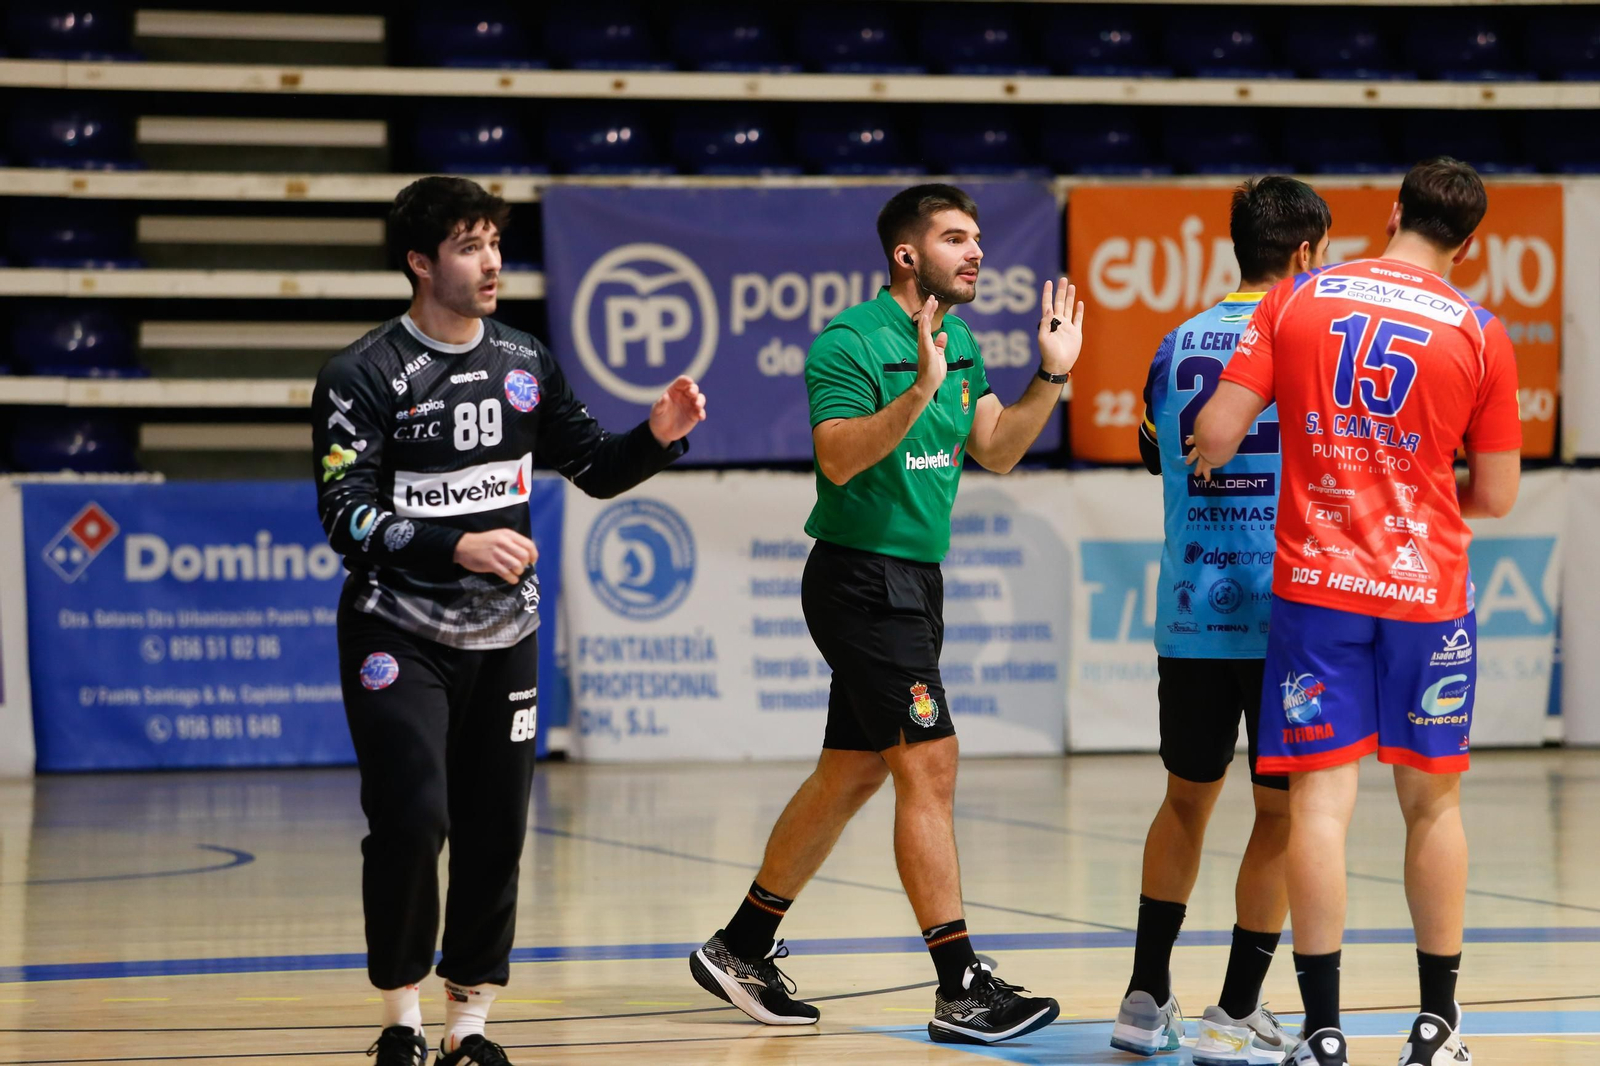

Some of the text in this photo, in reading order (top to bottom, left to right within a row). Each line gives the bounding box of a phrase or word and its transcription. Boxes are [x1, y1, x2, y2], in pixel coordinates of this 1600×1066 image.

[1347, 291, 1392, 304] GROUP
[1350, 281, 1463, 317] SAVILCON
[605, 295, 692, 368] PP
[1181, 332, 1196, 350] G.
[1329, 311, 1433, 417] 15
[453, 398, 503, 451] 89
[1305, 412, 1324, 435] S.
[906, 449, 951, 470] helvetia
[1312, 444, 1369, 462] PUNTO
[405, 475, 508, 508] helvetia
[1193, 478, 1268, 489] VITALDENT
[1187, 506, 1275, 522] OKEYMAS
[1240, 523, 1276, 531] CLUB
[1202, 546, 1277, 569] algetoner
[1291, 567, 1438, 605] DOS HERMANAS
[577, 628, 717, 664] FONTANERÍA
[578, 672, 720, 700] PROFESIONAL
[510, 706, 537, 742] 89
[1295, 722, 1334, 743] FIBRA
